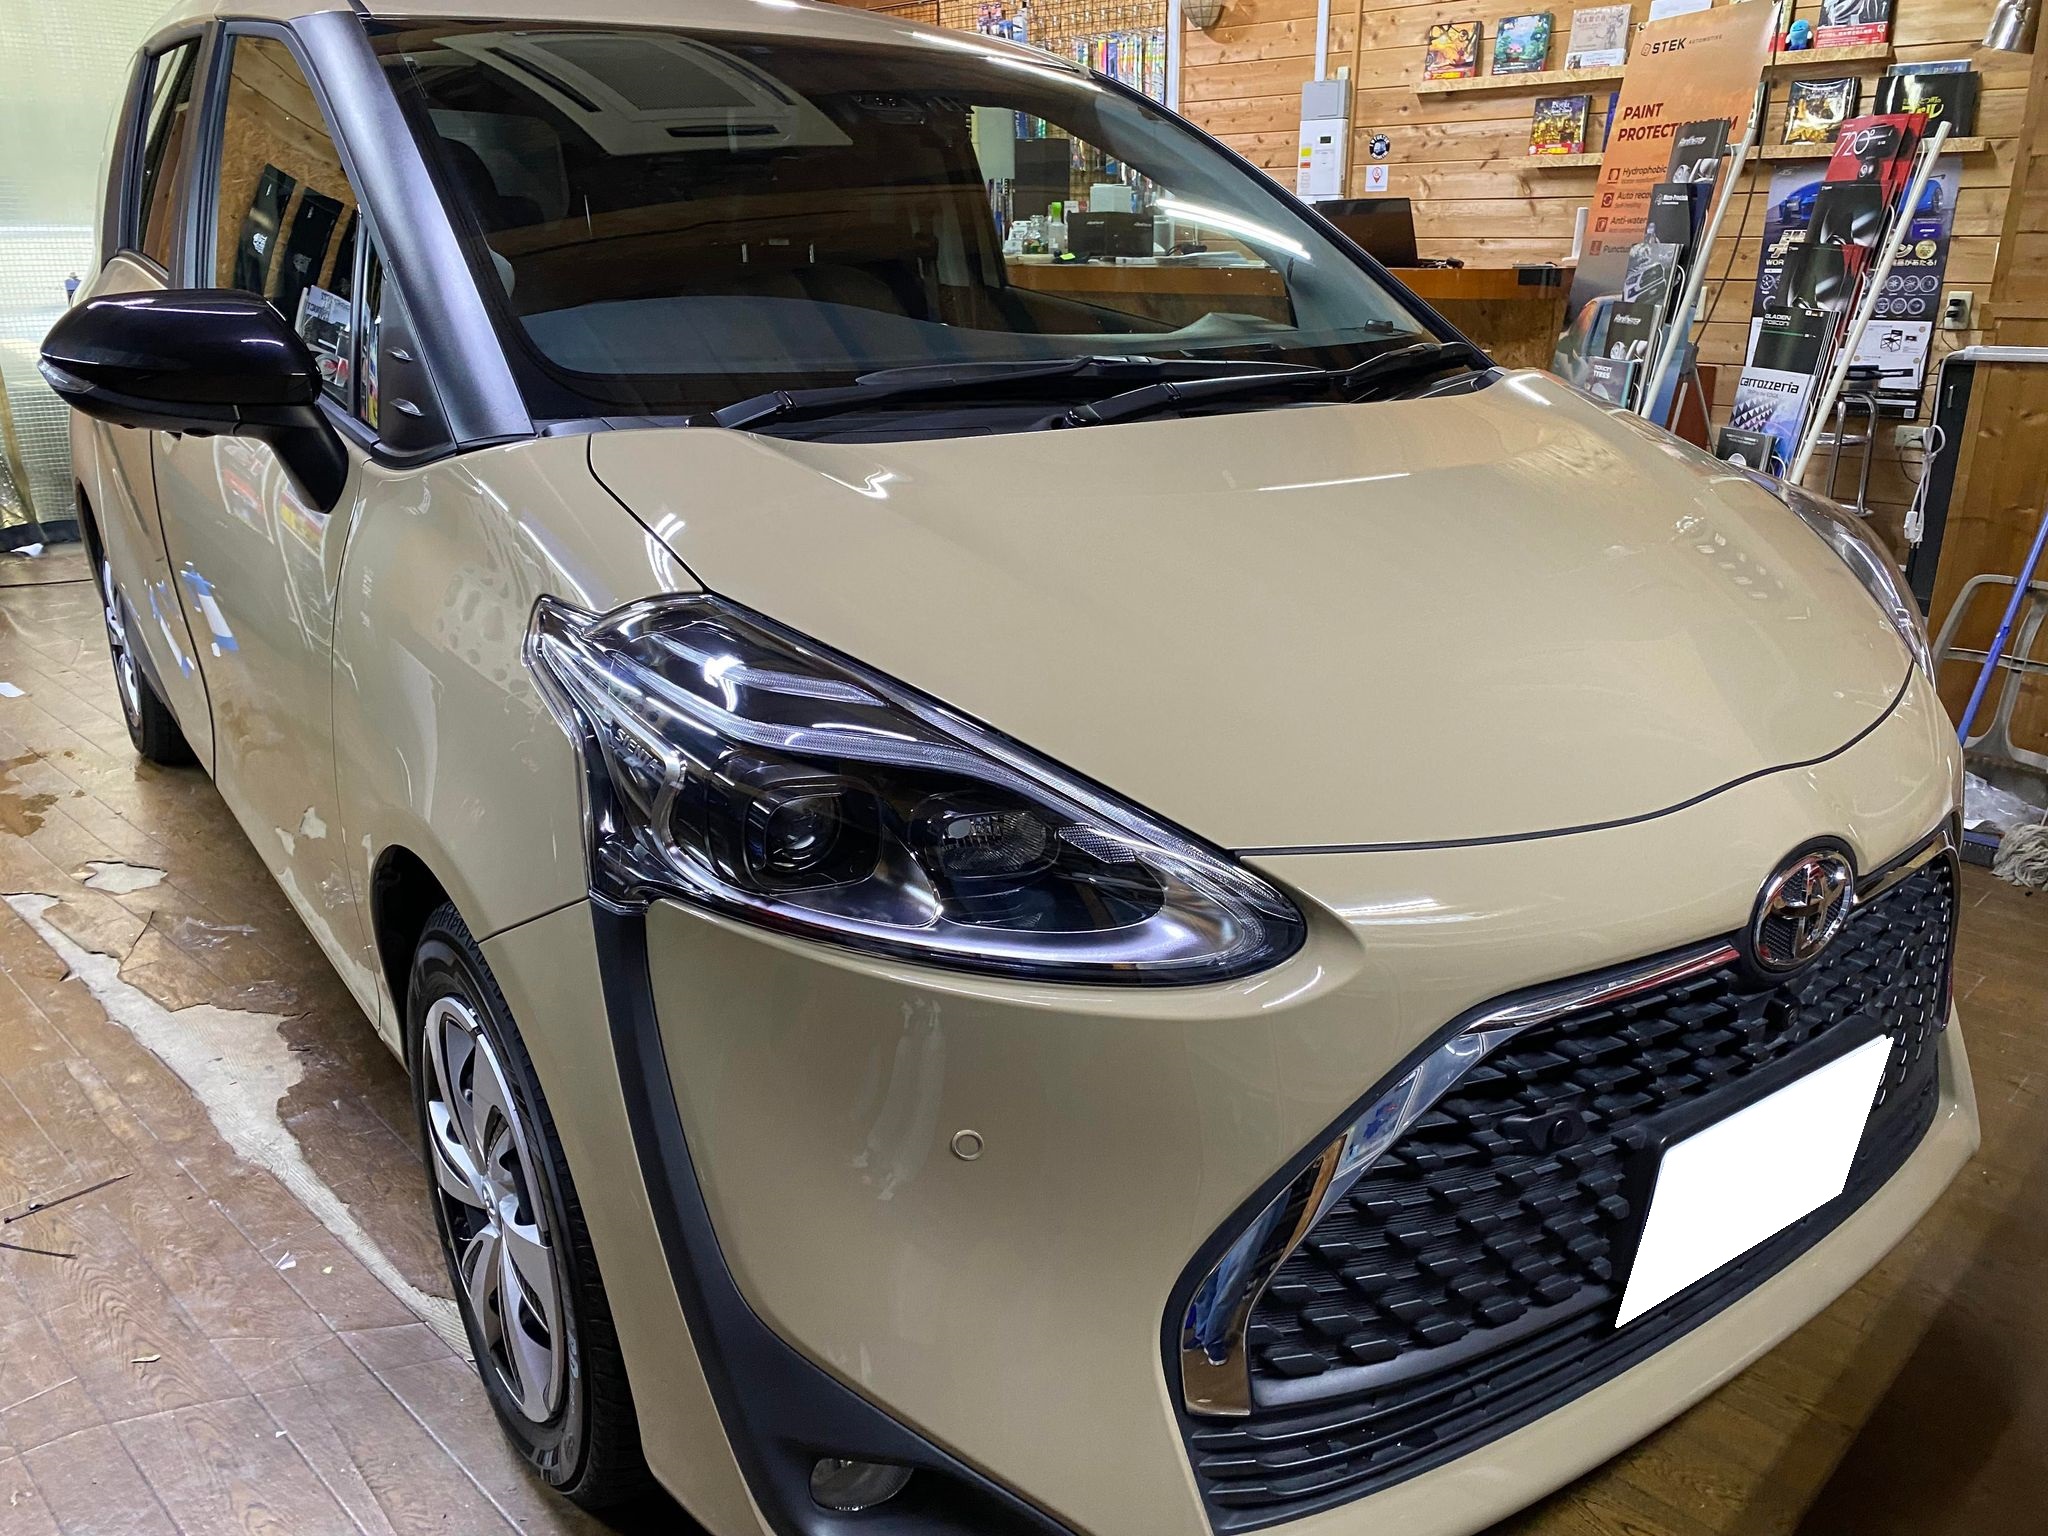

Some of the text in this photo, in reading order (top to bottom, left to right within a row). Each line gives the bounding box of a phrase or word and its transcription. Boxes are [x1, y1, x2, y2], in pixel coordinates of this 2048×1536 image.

[1652, 37, 1687, 54] STEK
[1623, 103, 1664, 120] PAINT
[1617, 121, 1698, 141] PROTECT
[1622, 165, 1668, 177] Hydrophobic
[1617, 191, 1634, 200] Auto
[1764, 313, 1791, 321] GLADEN
[1740, 377, 1799, 394] carrozzeria
